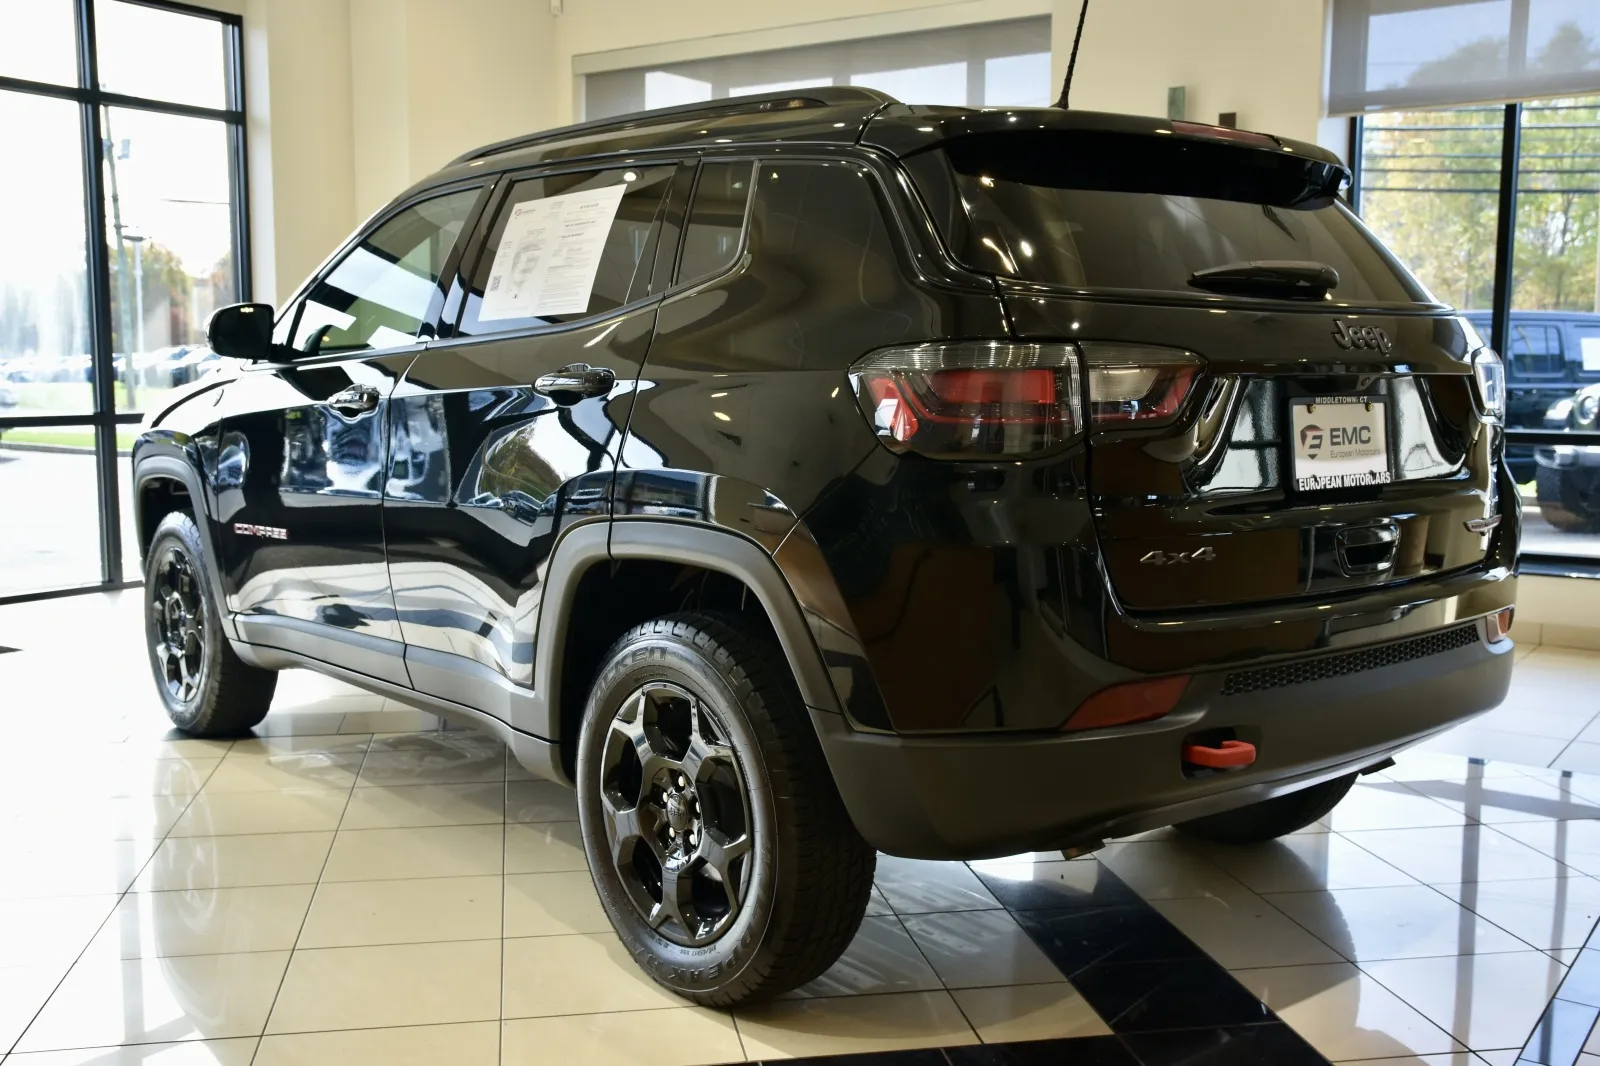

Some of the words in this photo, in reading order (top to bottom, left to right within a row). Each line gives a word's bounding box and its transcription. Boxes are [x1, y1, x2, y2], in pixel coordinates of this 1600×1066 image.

[1332, 318, 1391, 354] Jeep
[1359, 395, 1368, 403] CT
[1329, 425, 1371, 446] EMC
[1139, 546, 1217, 566] 4x4
